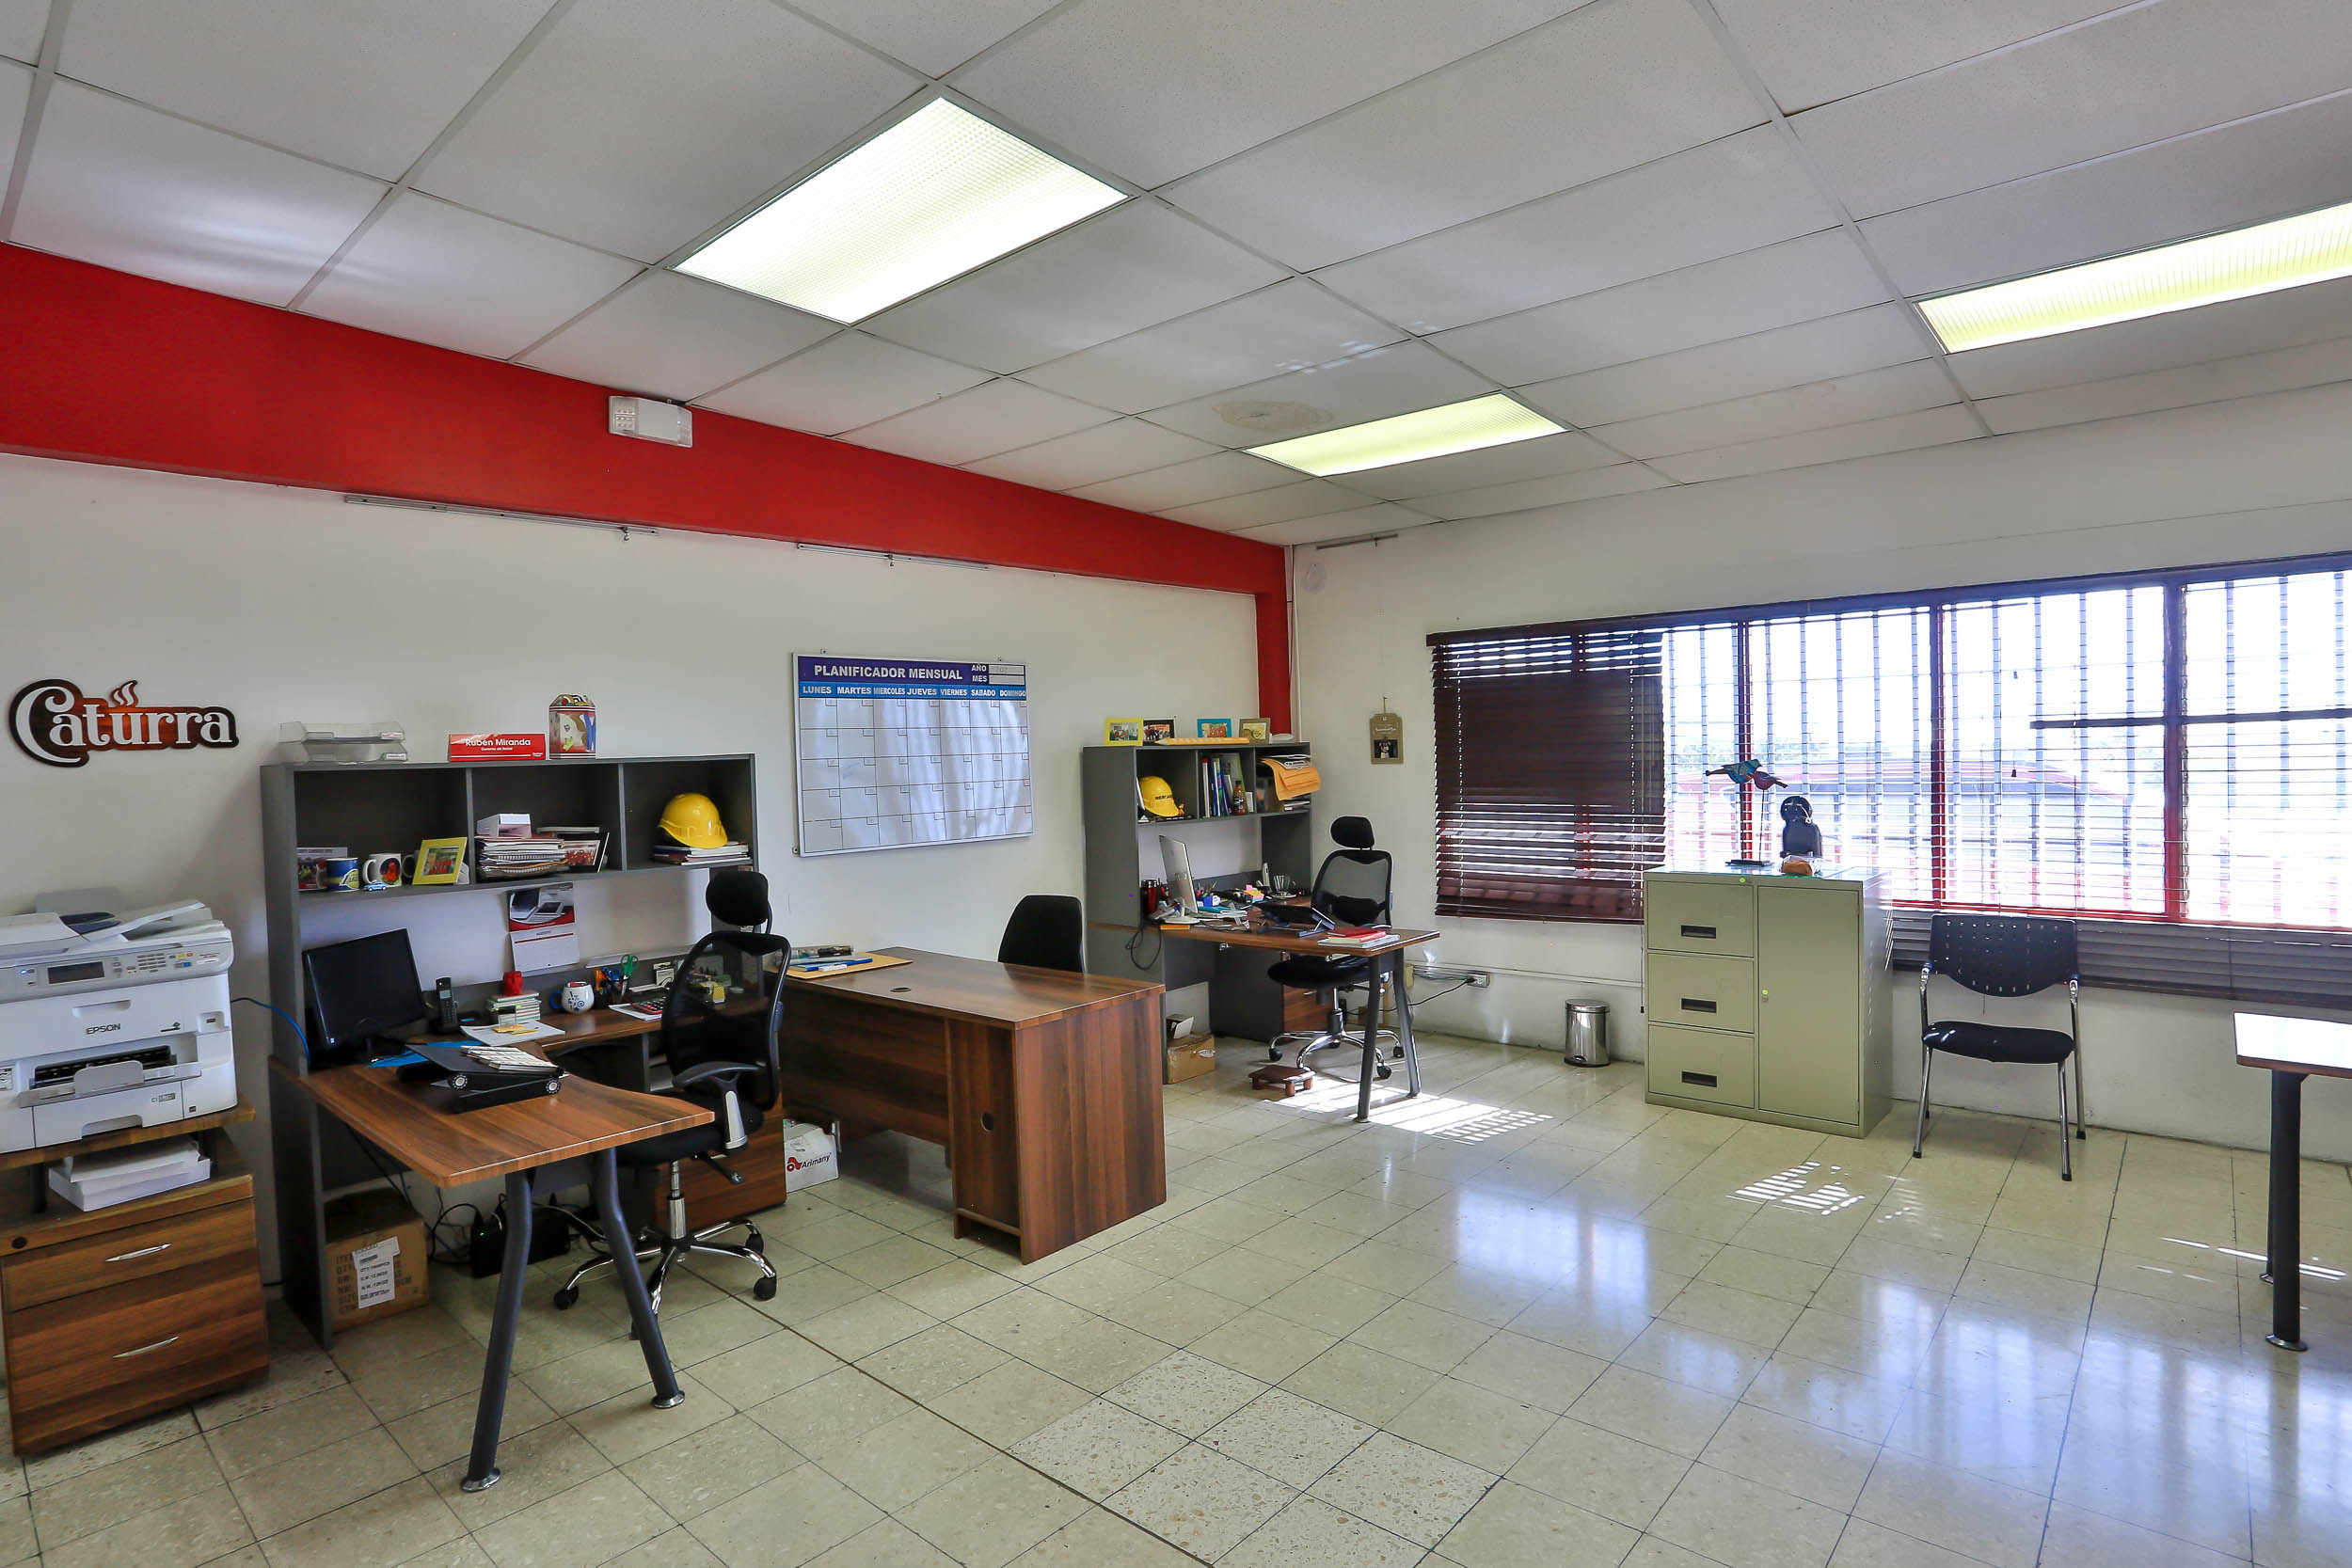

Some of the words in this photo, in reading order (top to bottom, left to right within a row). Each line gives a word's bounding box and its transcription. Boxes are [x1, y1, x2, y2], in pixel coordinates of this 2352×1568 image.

[814, 664, 906, 679] PLANIFICADOR
[909, 668, 963, 681] MENSUAL
[971, 662, 987, 672] AÑO
[803, 685, 833, 695] LUNES
[837, 686, 872, 696] MARTES
[907, 688, 937, 697] JUEVES
[940, 688, 968, 697] VIERNES
[971, 689, 996, 697] SABADO
[15, 686, 233, 764] Caturra
[87, 1022, 121, 1035] EPSON
[802, 1155, 830, 1168] Arimany
